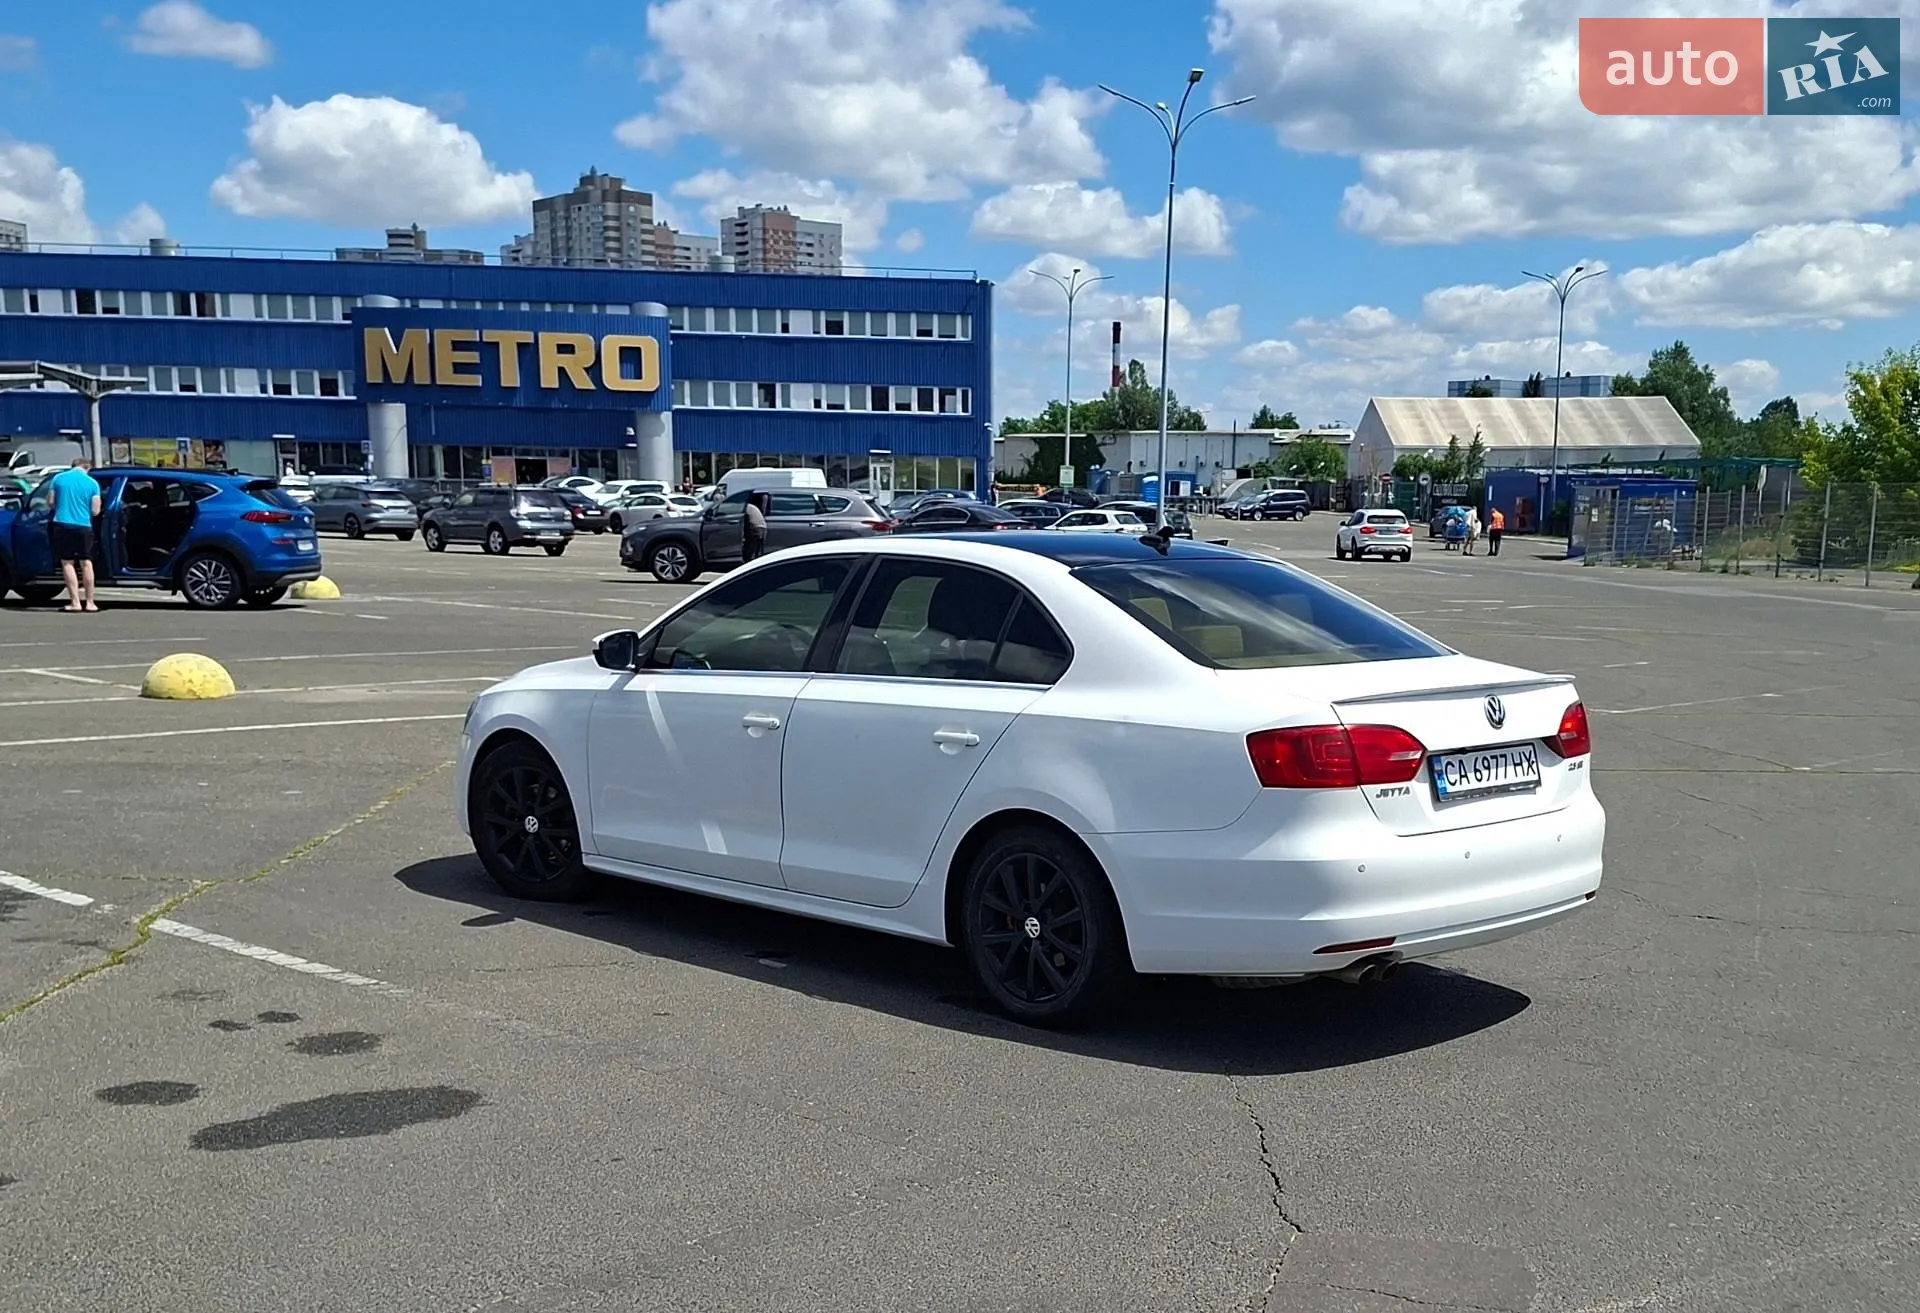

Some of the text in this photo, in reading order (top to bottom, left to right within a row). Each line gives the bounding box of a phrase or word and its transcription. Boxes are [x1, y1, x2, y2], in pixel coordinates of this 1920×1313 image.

[363, 327, 660, 392] METRO
[1444, 759, 1471, 786] CA
[1473, 753, 1508, 783] 6977
[1510, 749, 1536, 778] HX
[1375, 786, 1411, 799] JETTA
